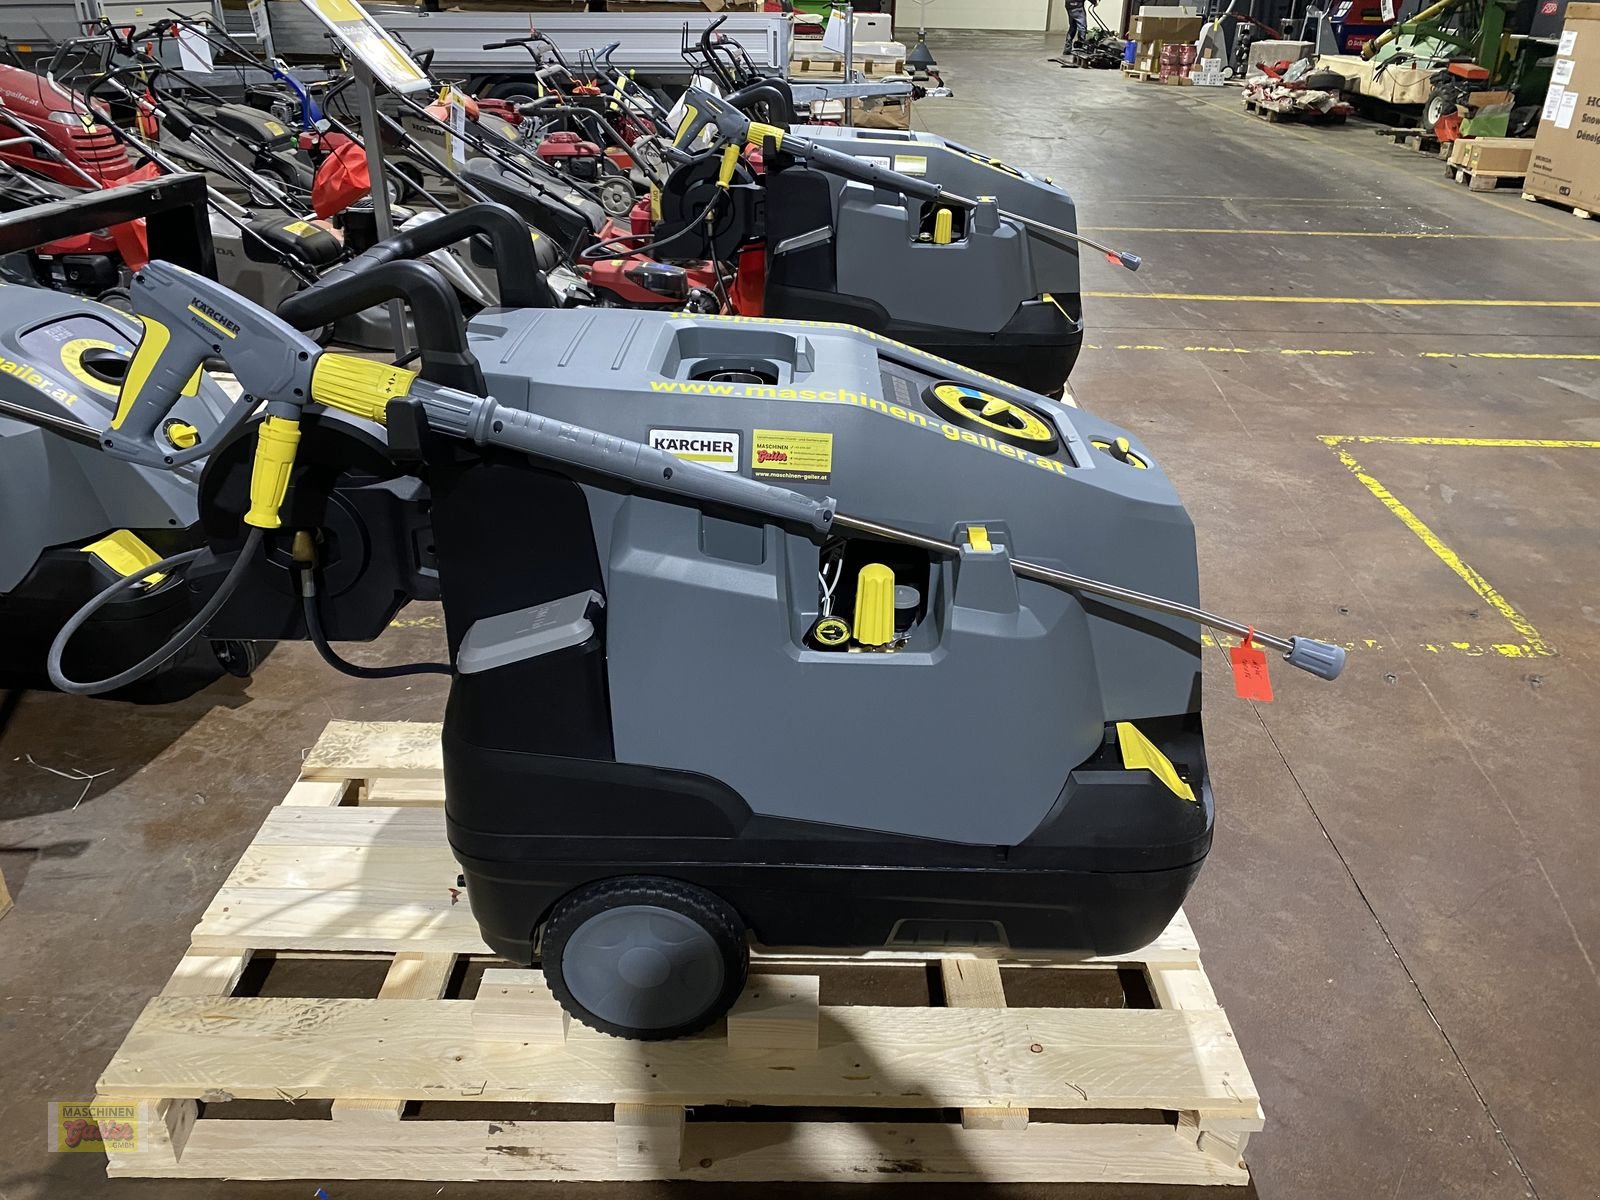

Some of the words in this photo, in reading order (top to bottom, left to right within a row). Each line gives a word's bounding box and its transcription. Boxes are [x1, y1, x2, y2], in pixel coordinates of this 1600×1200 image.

[650, 381, 1068, 476] www.maschinen-gailer.at
[654, 437, 733, 453] KÄRCHER
[755, 471, 828, 481] www.maschinen-gailer.at
